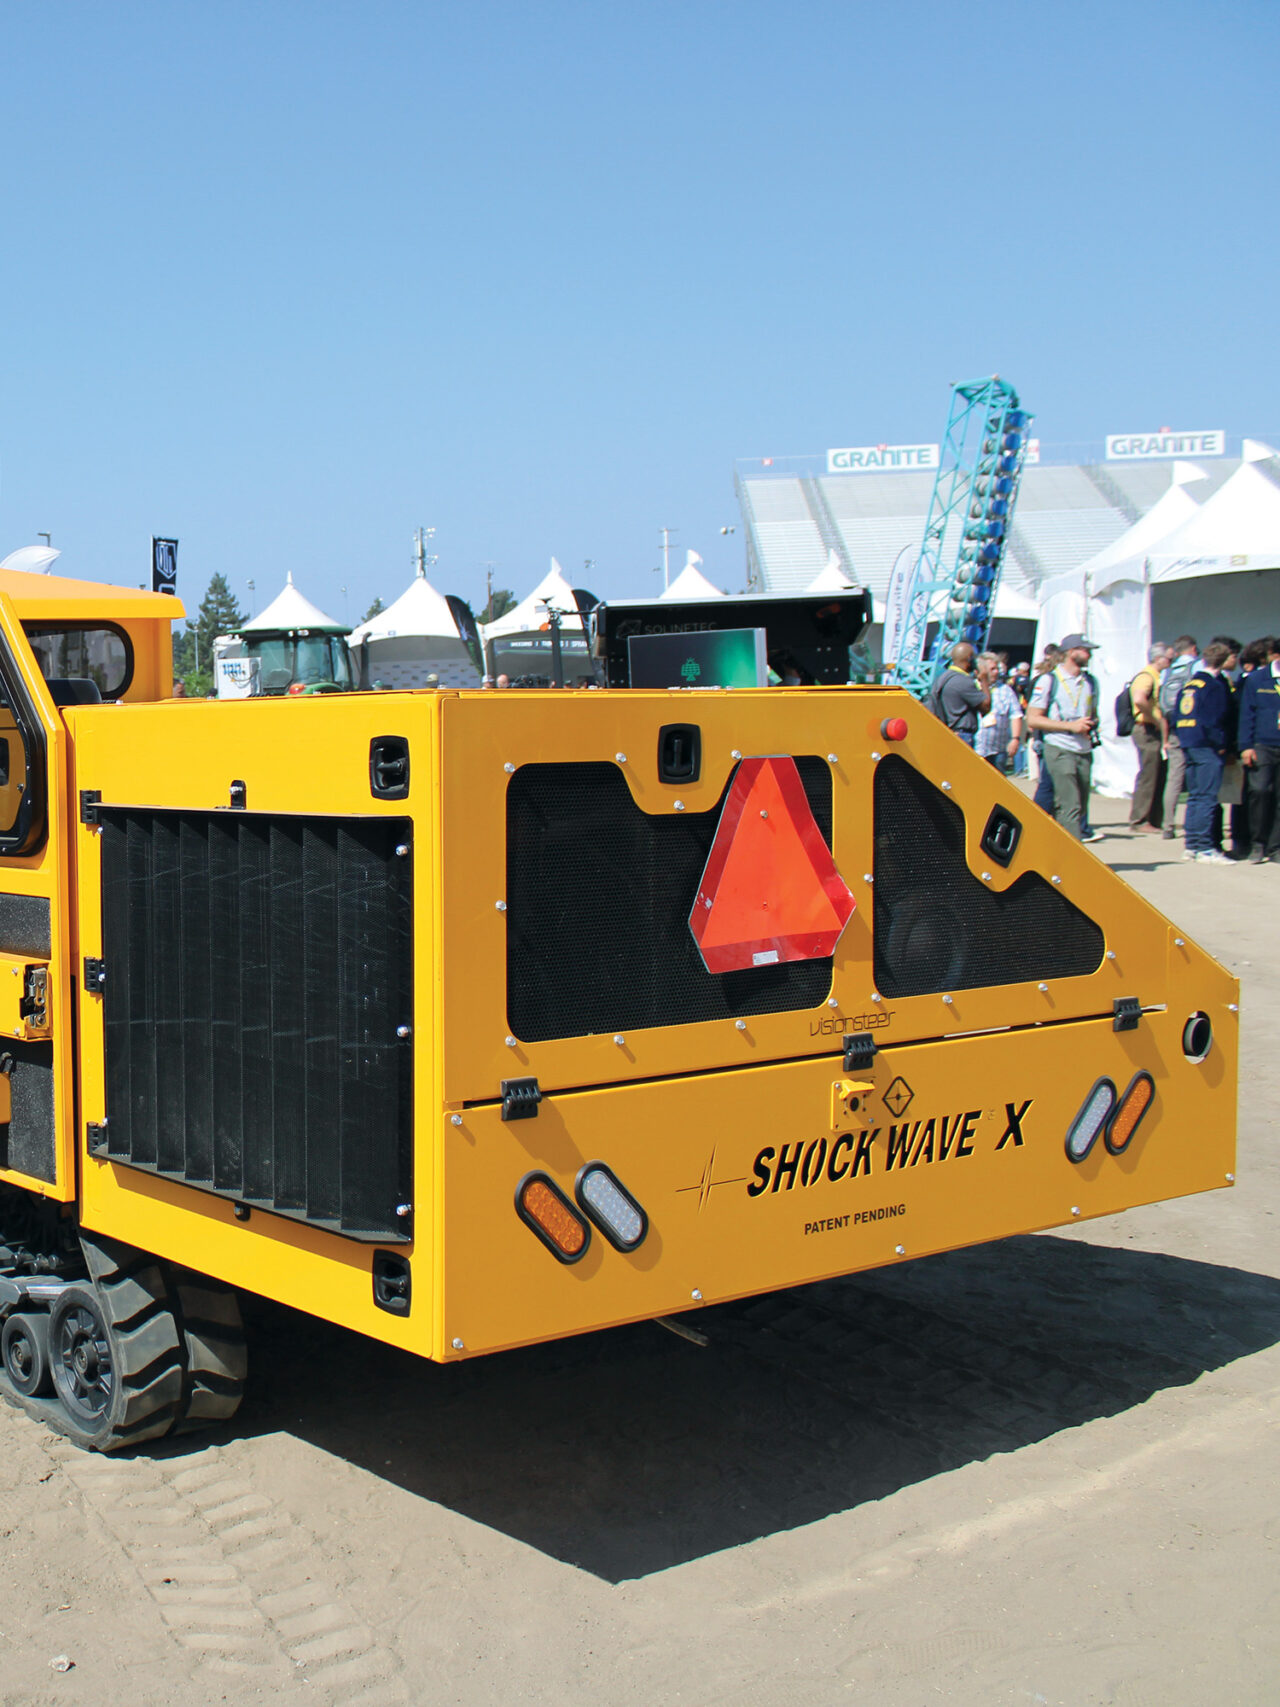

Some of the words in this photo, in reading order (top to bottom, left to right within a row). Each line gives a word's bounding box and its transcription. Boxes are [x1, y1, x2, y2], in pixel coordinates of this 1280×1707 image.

[832, 447, 931, 468] GRANITE
[1111, 434, 1217, 456] GRANITE
[746, 1127, 882, 1198] SHOCK
[885, 1109, 983, 1172] WAVE
[994, 1099, 1035, 1151] X
[804, 1214, 851, 1236] PATENT
[853, 1203, 907, 1226] PENDING
